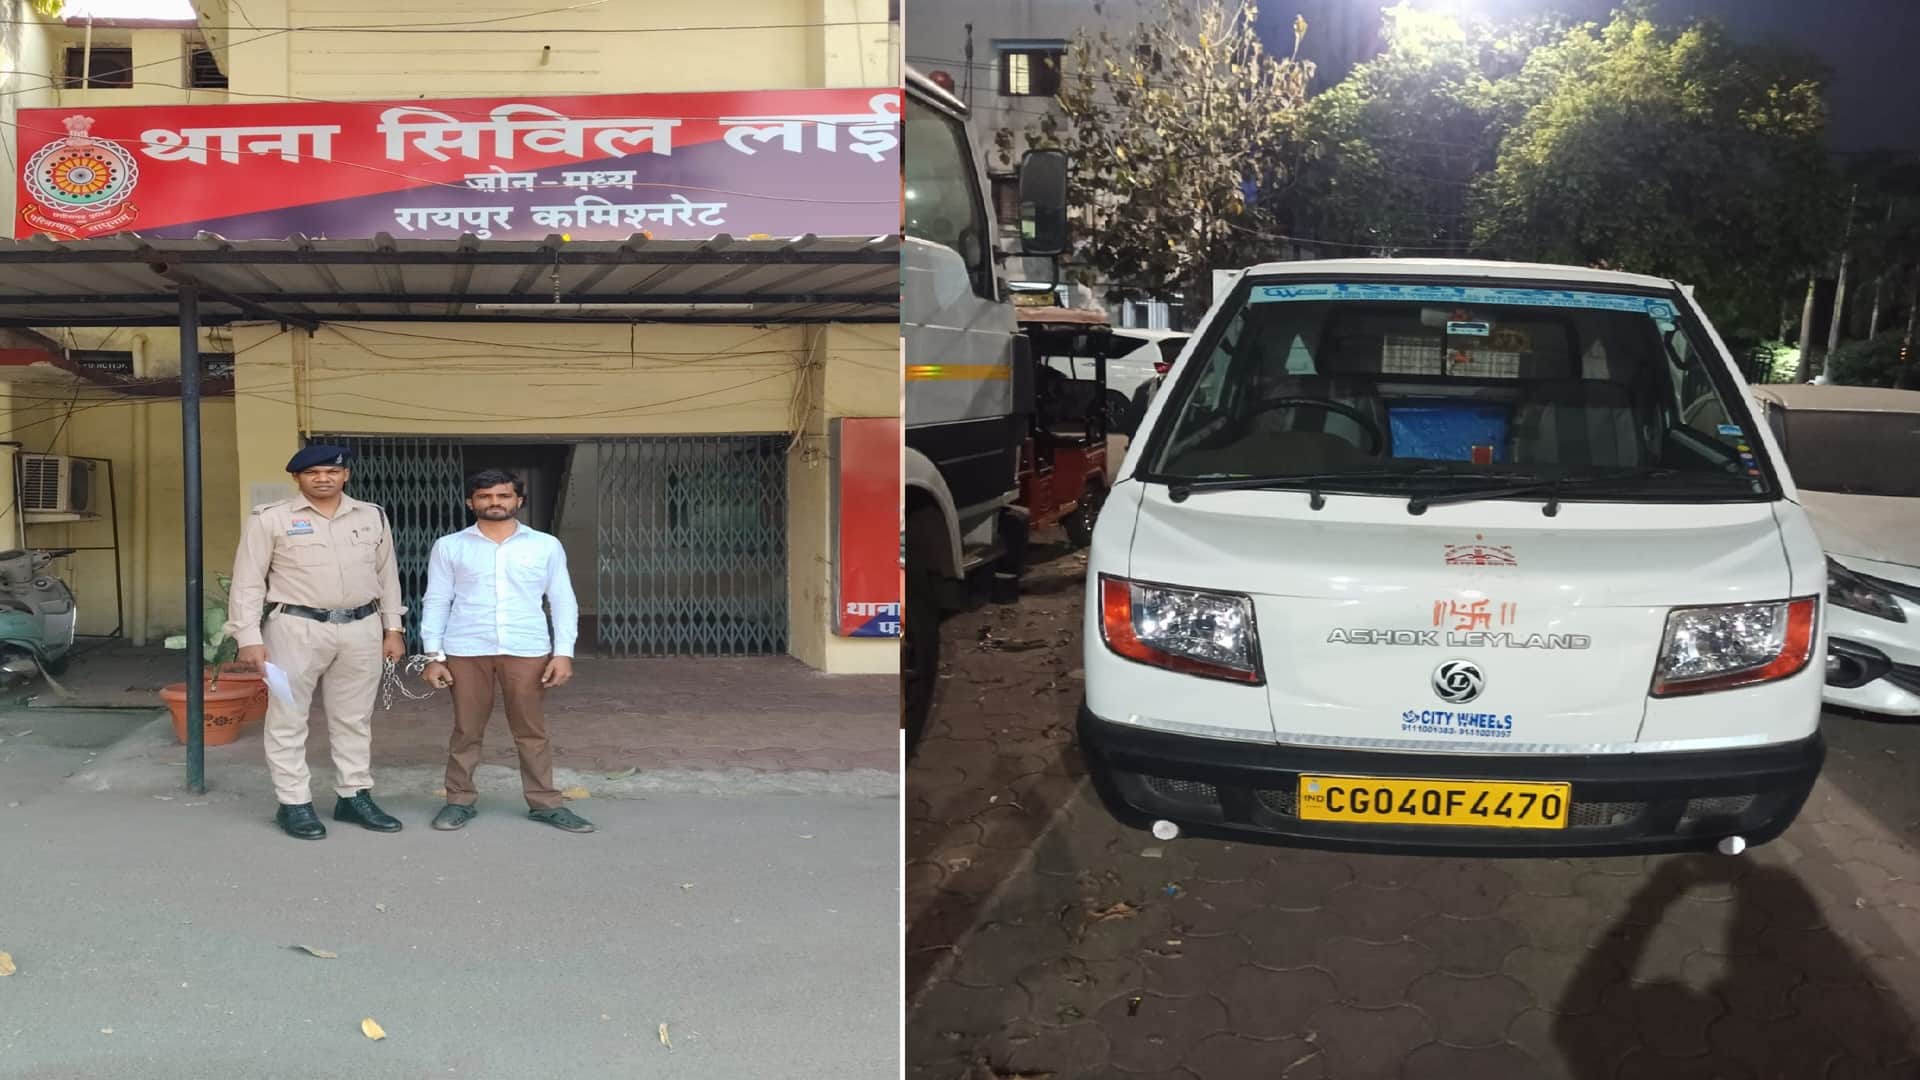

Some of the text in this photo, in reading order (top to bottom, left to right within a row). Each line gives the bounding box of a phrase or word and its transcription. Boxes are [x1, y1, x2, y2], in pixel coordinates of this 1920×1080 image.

[139, 93, 900, 164] थाना सिविल लाई
[562, 170, 637, 190] मध्य
[394, 194, 728, 240] रायपुर कमिश्नरेट
[1327, 628, 1592, 650] ASHOK LEYLAND
[1421, 710, 1512, 730] CITY WHEELS
